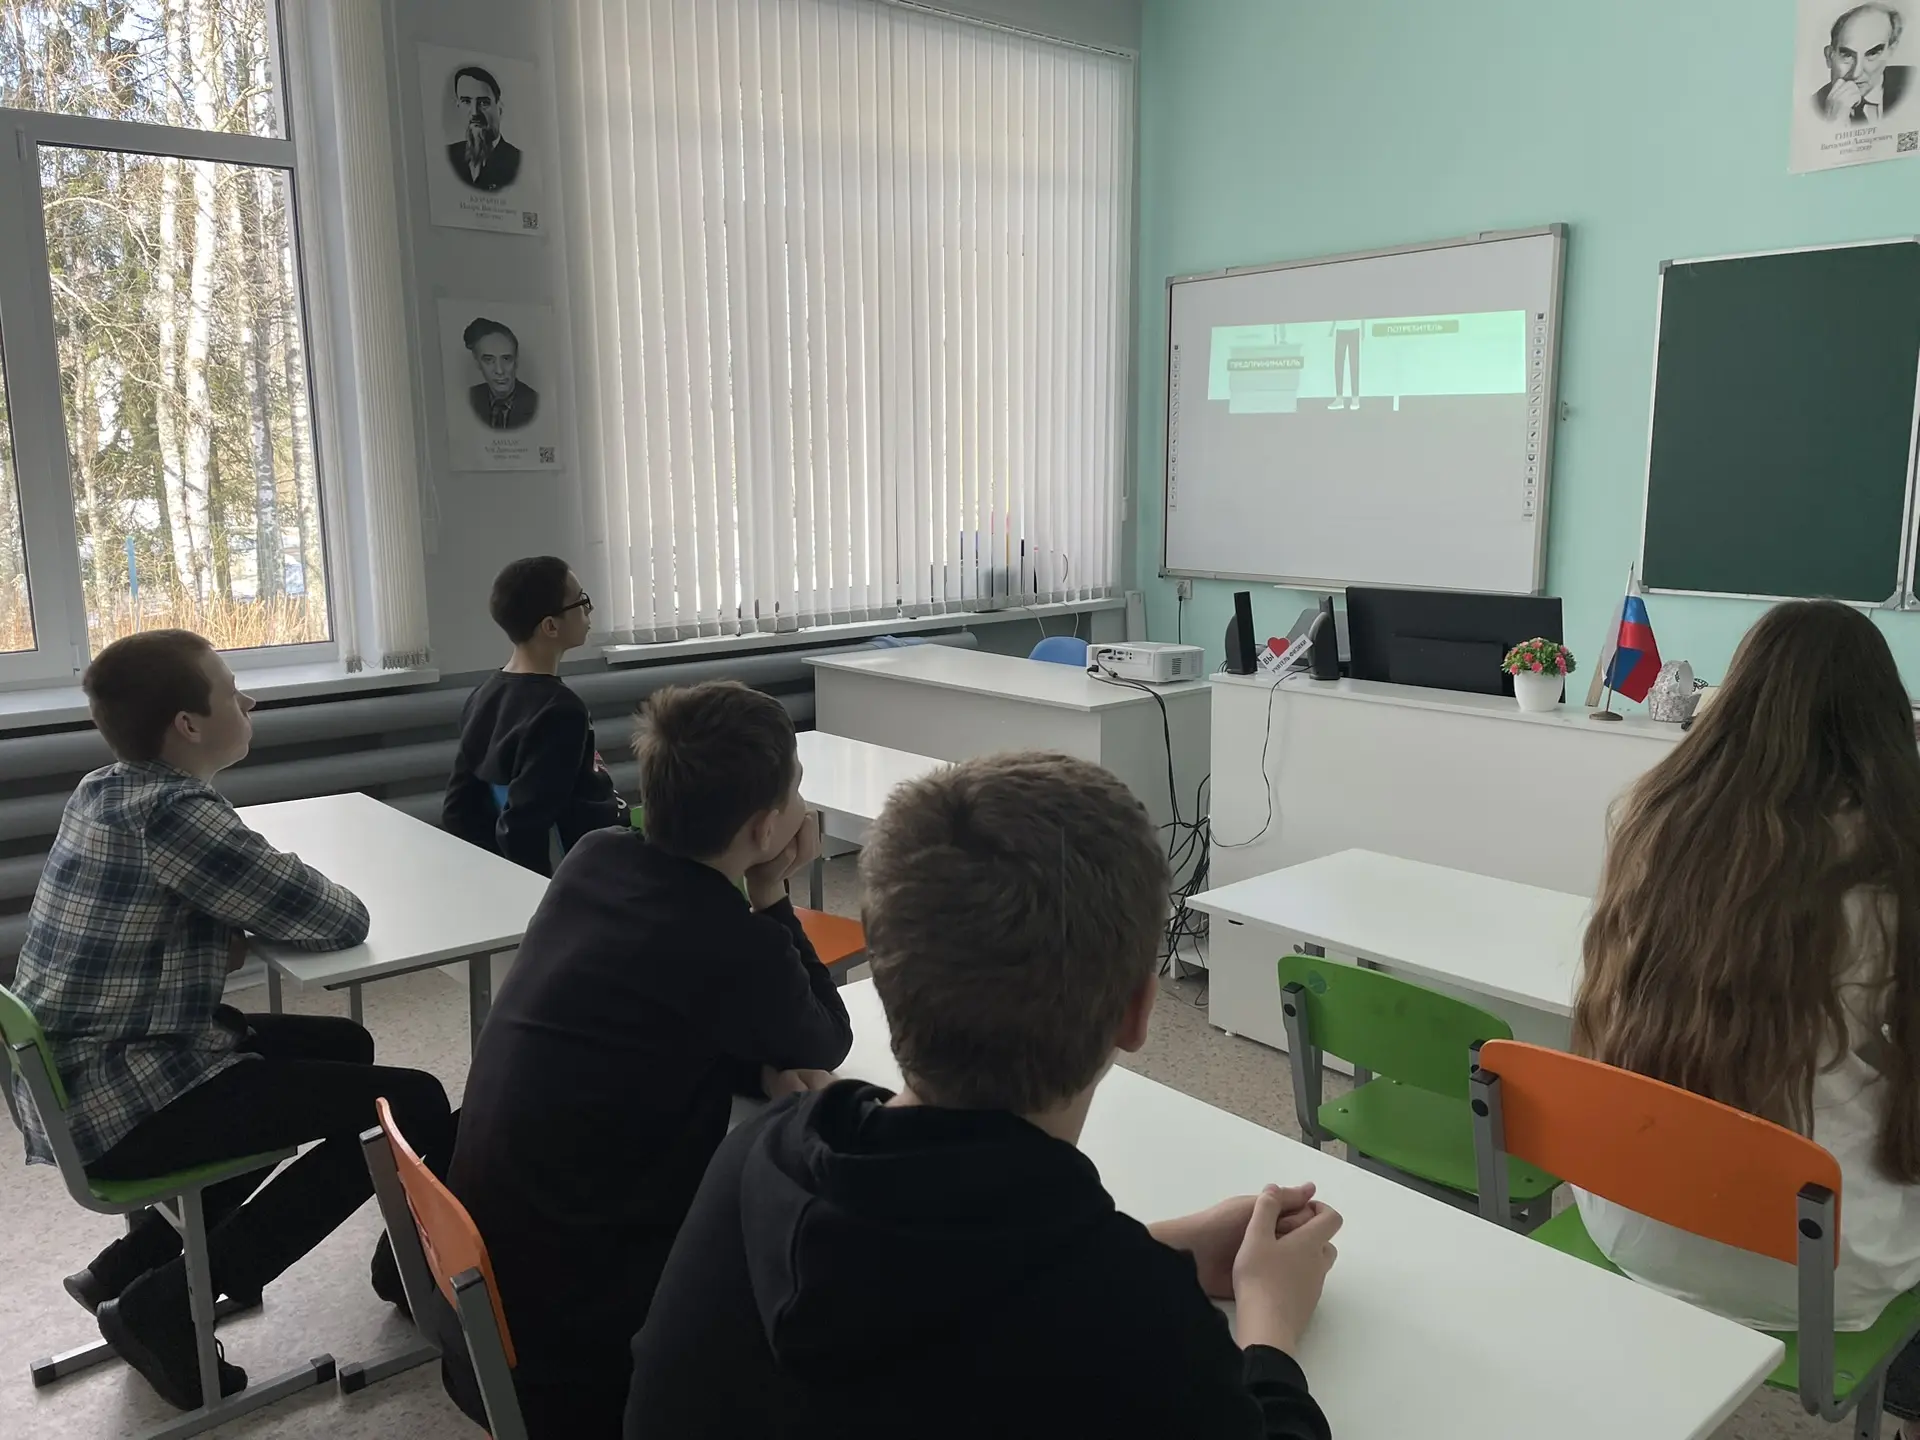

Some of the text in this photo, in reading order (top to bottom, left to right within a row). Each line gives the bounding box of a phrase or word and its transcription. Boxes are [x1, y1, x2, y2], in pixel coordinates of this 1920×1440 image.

[1387, 324, 1443, 332] ПОТРЕБИТЕЛЬ
[1230, 359, 1301, 368] ПРЕДПРИНИМАТЕЛЬ
[1263, 653, 1275, 665] ВЫ
[1272, 640, 1307, 673] УЧИТЕЛЬ ФИЗИКИ
